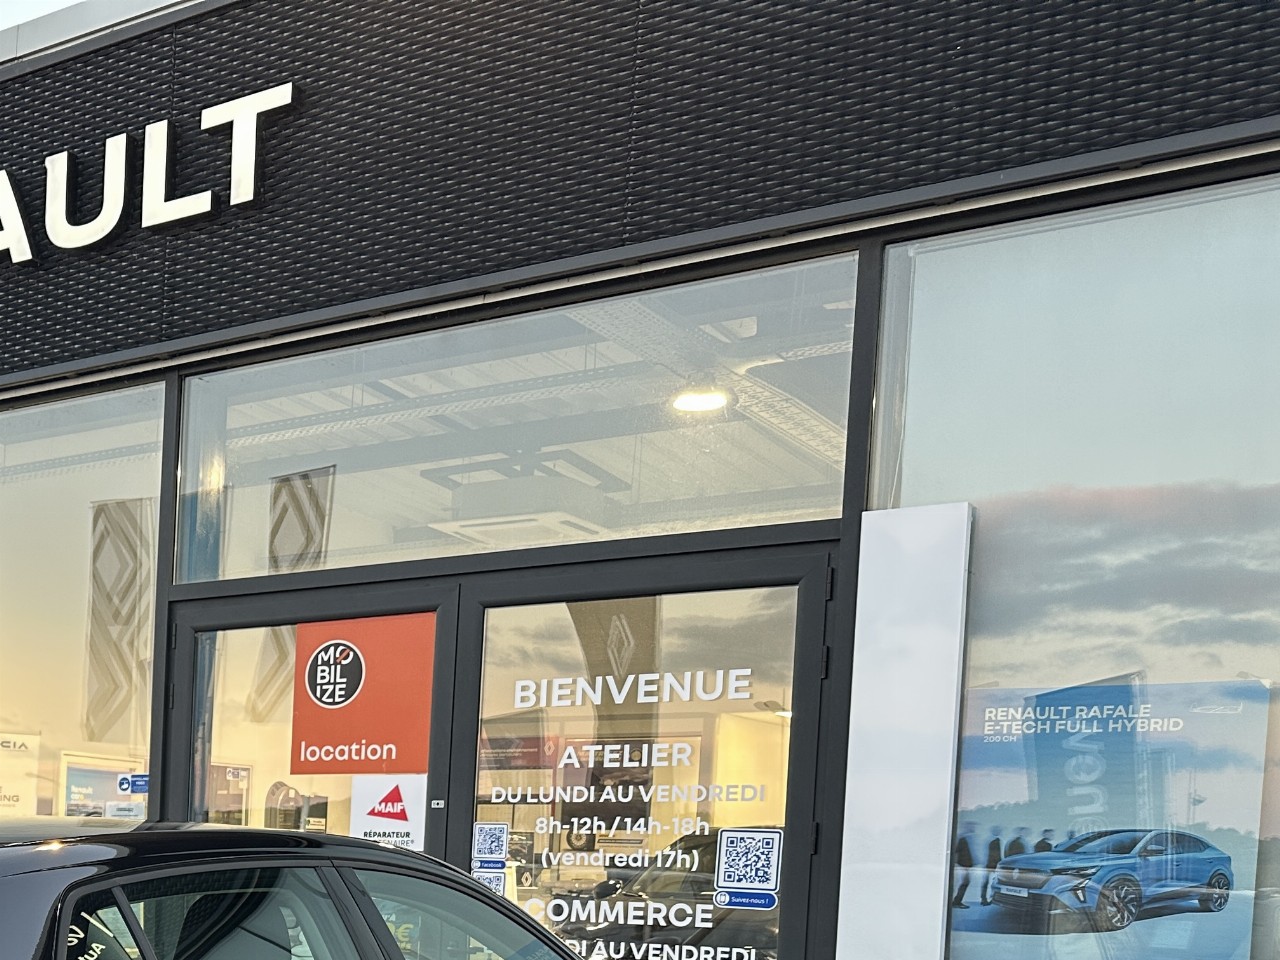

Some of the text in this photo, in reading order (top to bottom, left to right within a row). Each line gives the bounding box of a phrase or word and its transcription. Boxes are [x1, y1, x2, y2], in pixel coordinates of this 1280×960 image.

[513, 668, 752, 709] BIENVENUE
[984, 704, 1152, 721] RENAULT RAFALE
[983, 717, 1184, 735] E-TECH FULL HYBRID
[983, 735, 1017, 743] 200 CH
[299, 739, 397, 762] location
[558, 743, 692, 769] ATELIER
[490, 784, 766, 803] DU LUNDI AU VENDREDI
[374, 801, 405, 814] MAIF
[363, 829, 411, 839] RÉPARATEUR
[540, 848, 700, 872] (vendredi 17h)
[523, 898, 714, 929] COMMERCE
[591, 940, 625, 960] AU
